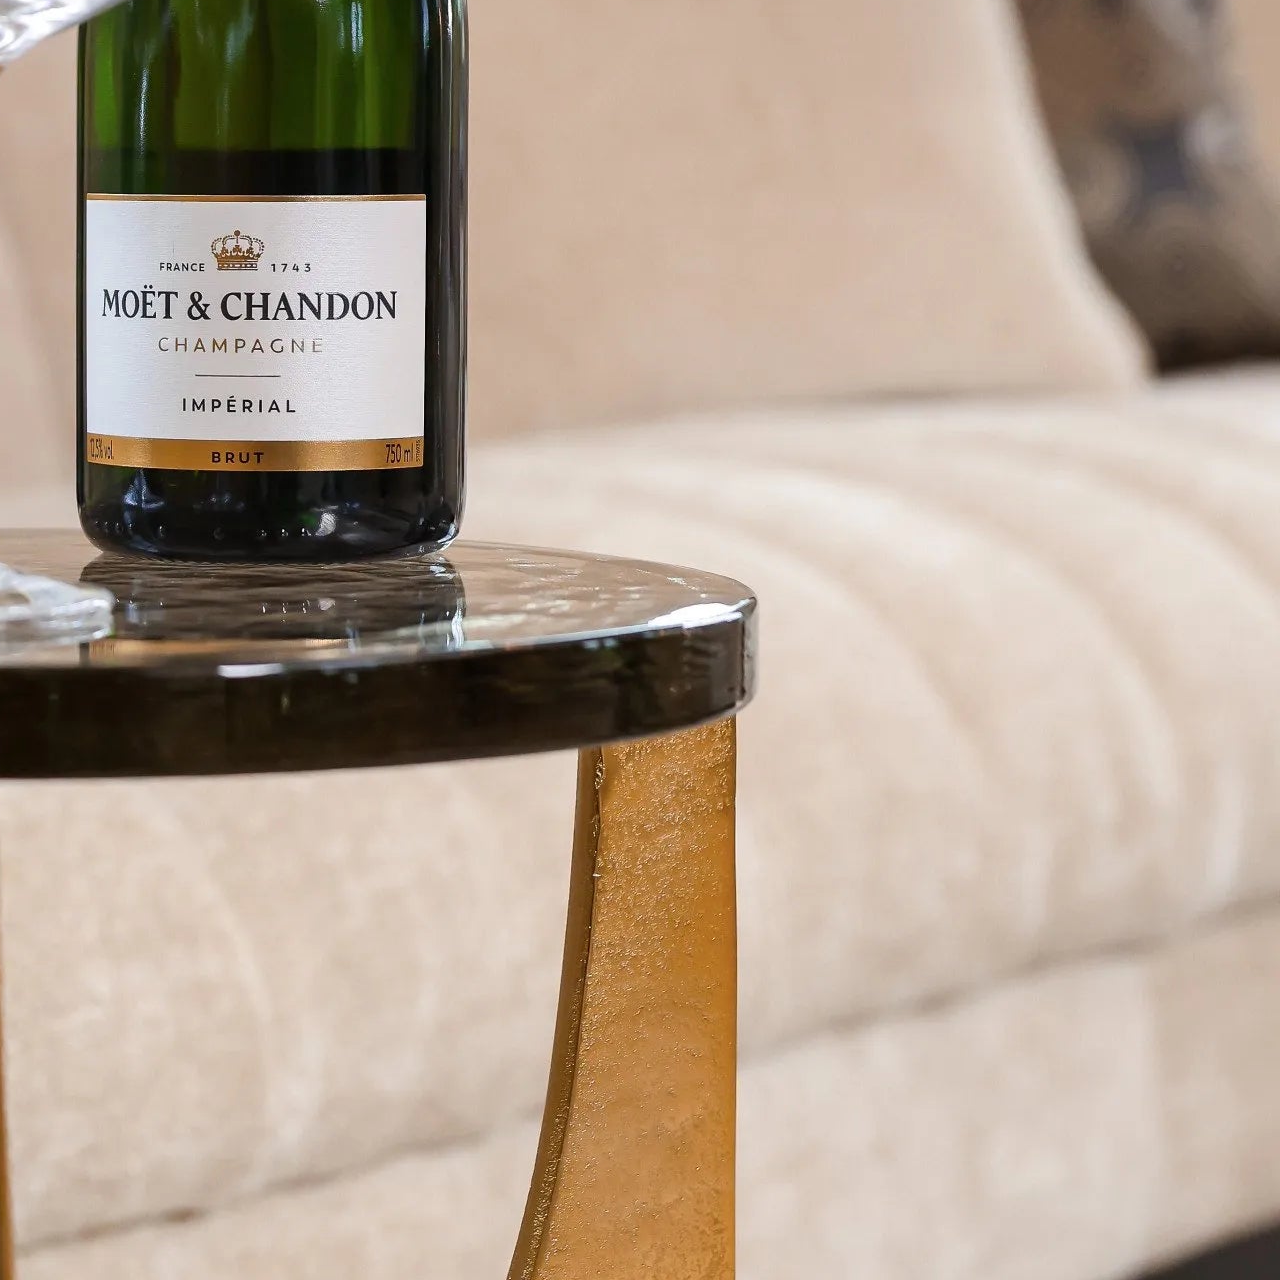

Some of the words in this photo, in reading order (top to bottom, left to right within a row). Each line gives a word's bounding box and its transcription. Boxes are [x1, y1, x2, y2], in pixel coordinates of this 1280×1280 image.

[159, 262, 206, 272] FRANCE
[270, 263, 312, 273] 1743
[102, 284, 179, 320] MOËT
[187, 290, 212, 321] &
[220, 290, 398, 321] CHANDON
[158, 336, 324, 354] CHAMPAGNE
[181, 395, 297, 413] IMPÉRIAL
[211, 451, 265, 464] BRUT
[385, 443, 401, 463] 750
